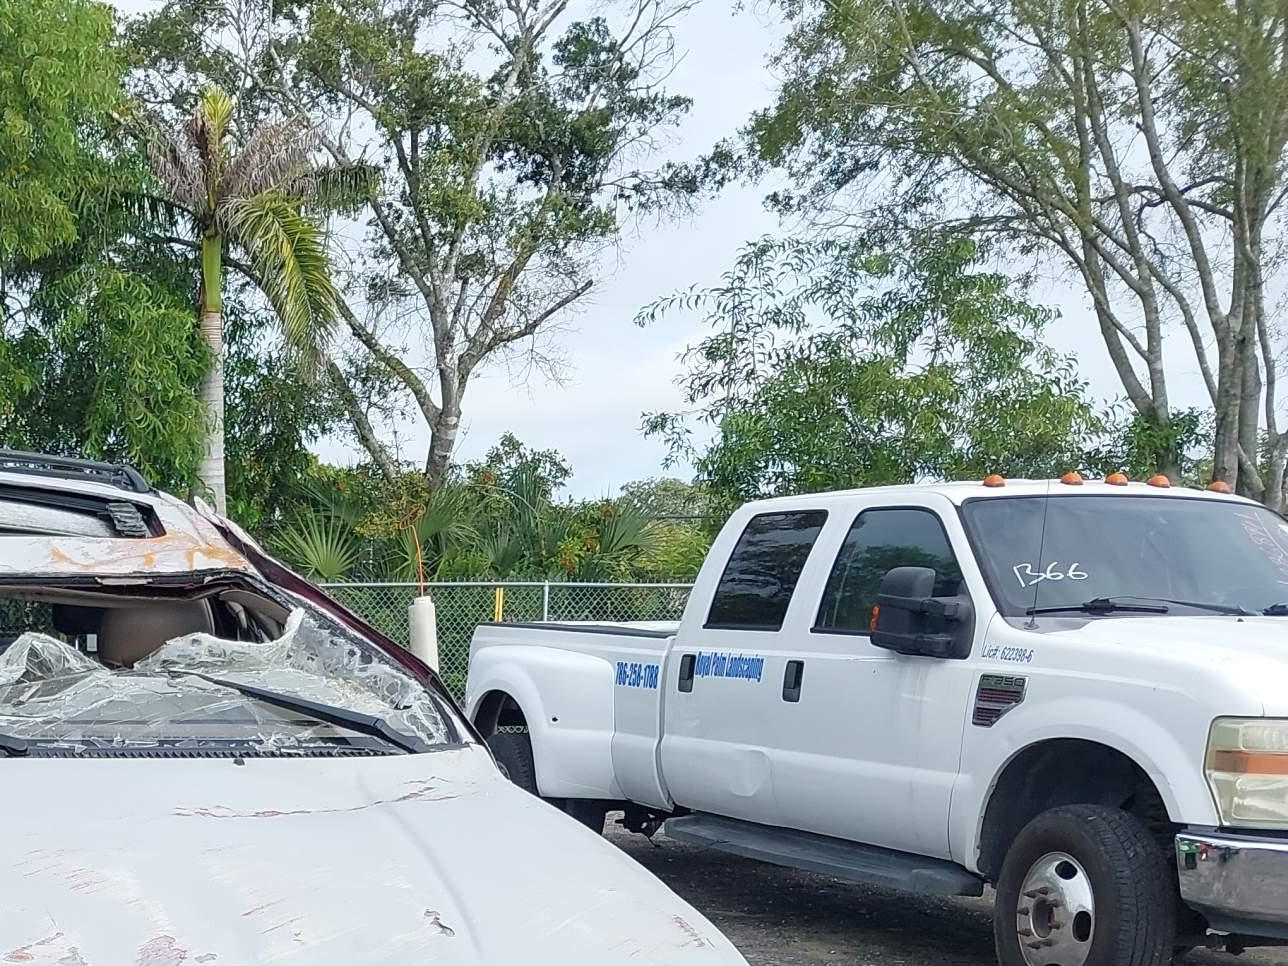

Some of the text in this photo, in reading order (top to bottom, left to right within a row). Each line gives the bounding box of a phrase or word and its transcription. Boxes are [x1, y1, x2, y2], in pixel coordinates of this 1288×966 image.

[1013, 562, 1089, 587] B66
[695, 651, 765, 683] Royal Palm Landscaping
